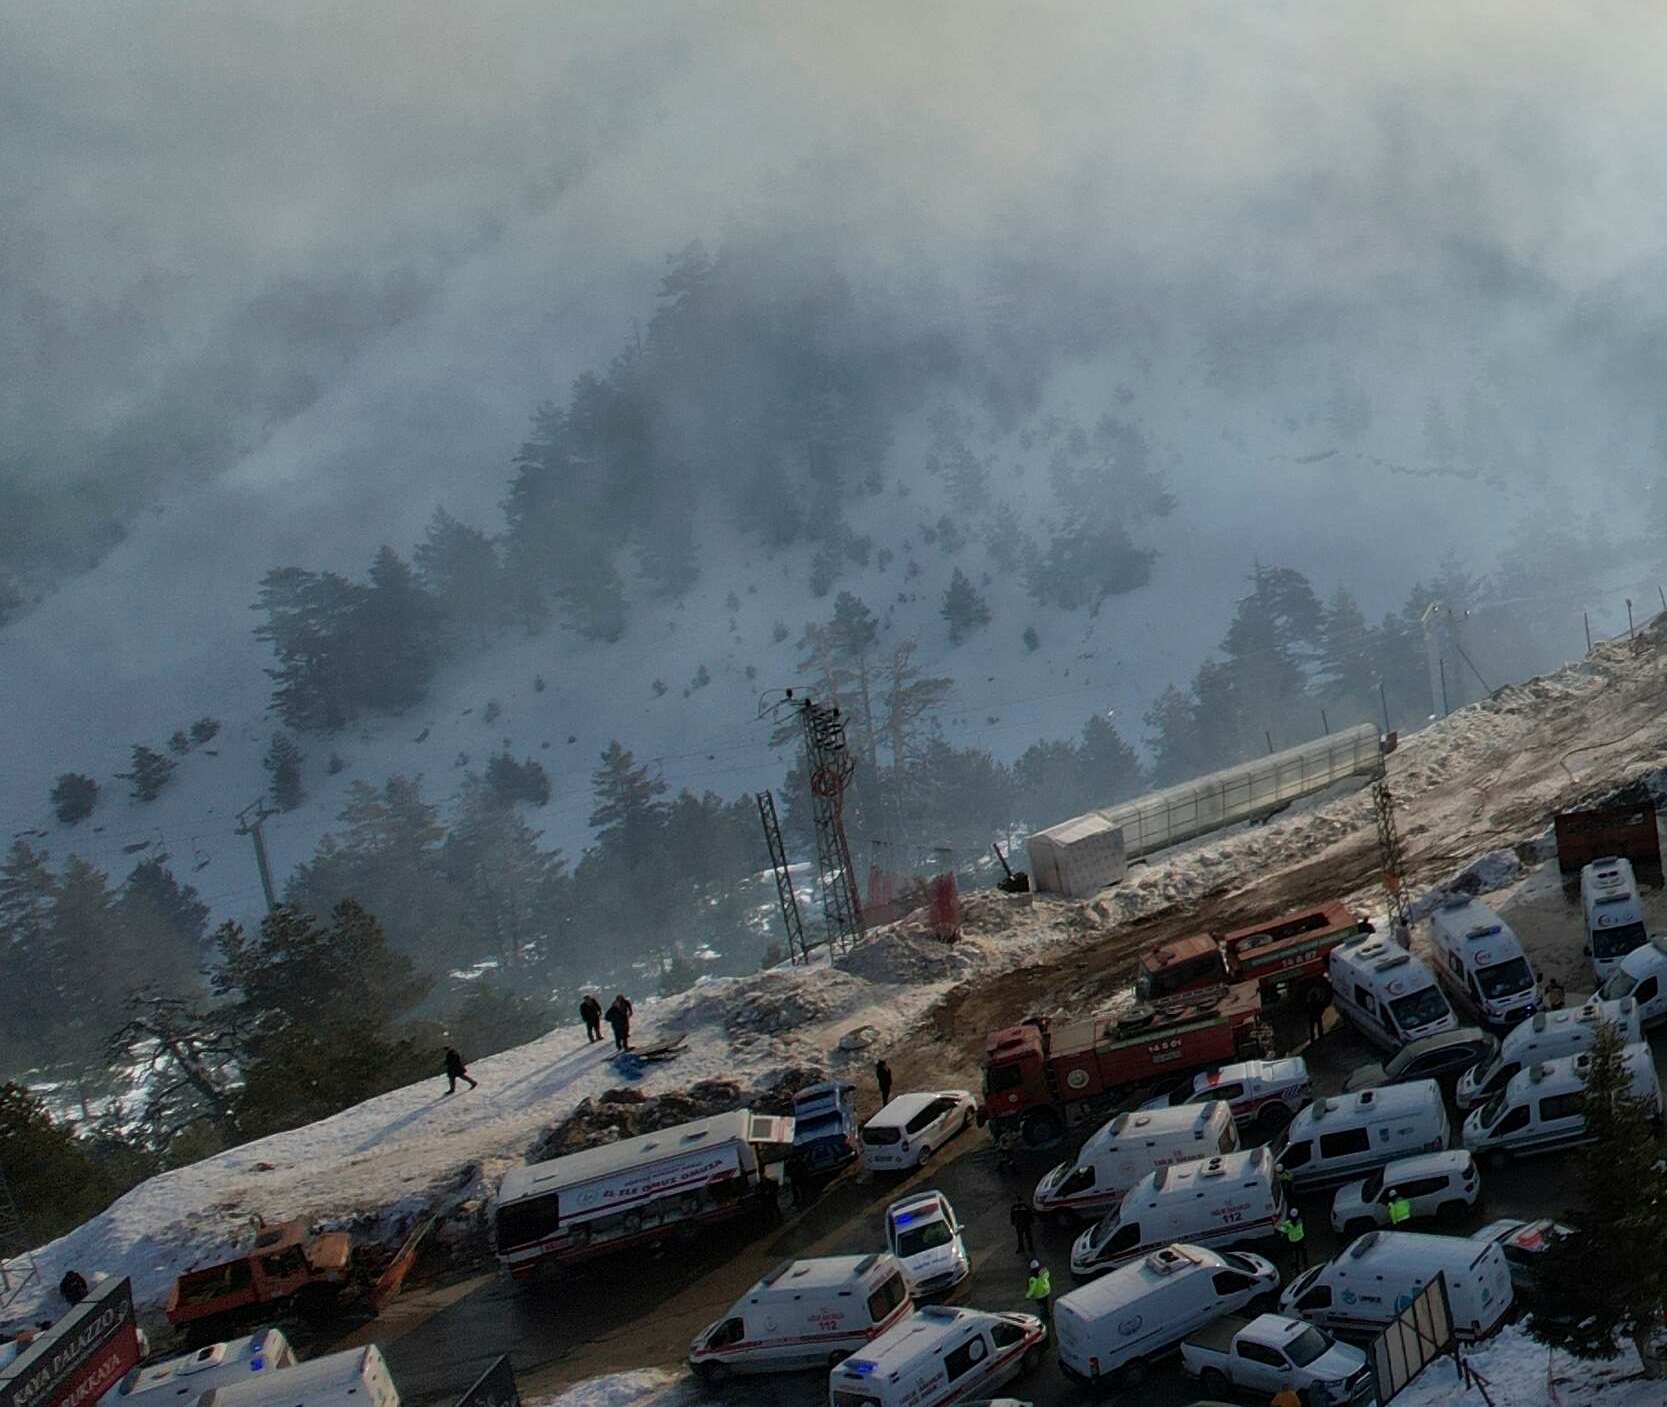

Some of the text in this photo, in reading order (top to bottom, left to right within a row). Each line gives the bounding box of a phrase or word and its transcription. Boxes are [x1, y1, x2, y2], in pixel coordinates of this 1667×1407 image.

[1224, 1213, 1242, 1224] 112
[819, 1321, 838, 1331] 112
[53, 1307, 115, 1382] PALAZZO
